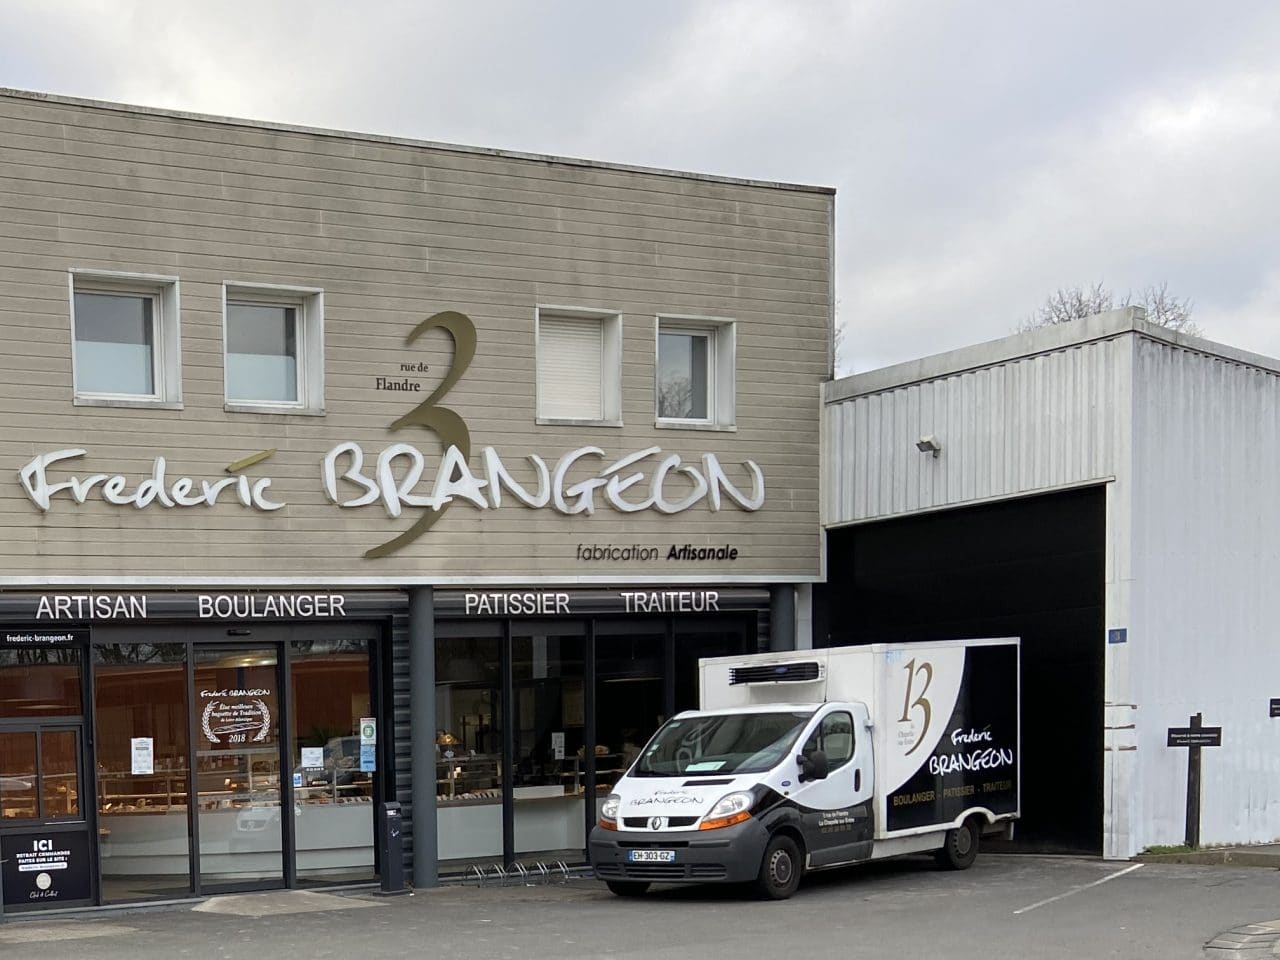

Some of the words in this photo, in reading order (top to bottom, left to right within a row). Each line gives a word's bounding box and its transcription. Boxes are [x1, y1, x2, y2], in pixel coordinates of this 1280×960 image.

[400, 363, 415, 372] rue
[417, 362, 428, 372] de
[376, 378, 420, 392] Flandre
[323, 440, 765, 519] BRANGEON
[577, 543, 659, 561] fabrication
[666, 544, 738, 560] Artisanale
[36, 595, 147, 619] ARTISAN
[198, 594, 346, 618] BOULANGER
[465, 593, 570, 615] PATISSIER
[620, 592, 720, 612] TRAITEUR
[6, 634, 74, 644] frederic-brangeon.fr
[228, 734, 246, 742] 2018
[929, 748, 1013, 776] BRANGEON
[630, 796, 704, 806] BRANGEON
[894, 790, 935, 806] BOULANGER
[943, 785, 975, 798] PATISSIER
[983, 780, 1012, 792] TRAITEUR
[33, 840, 52, 851] ICI
